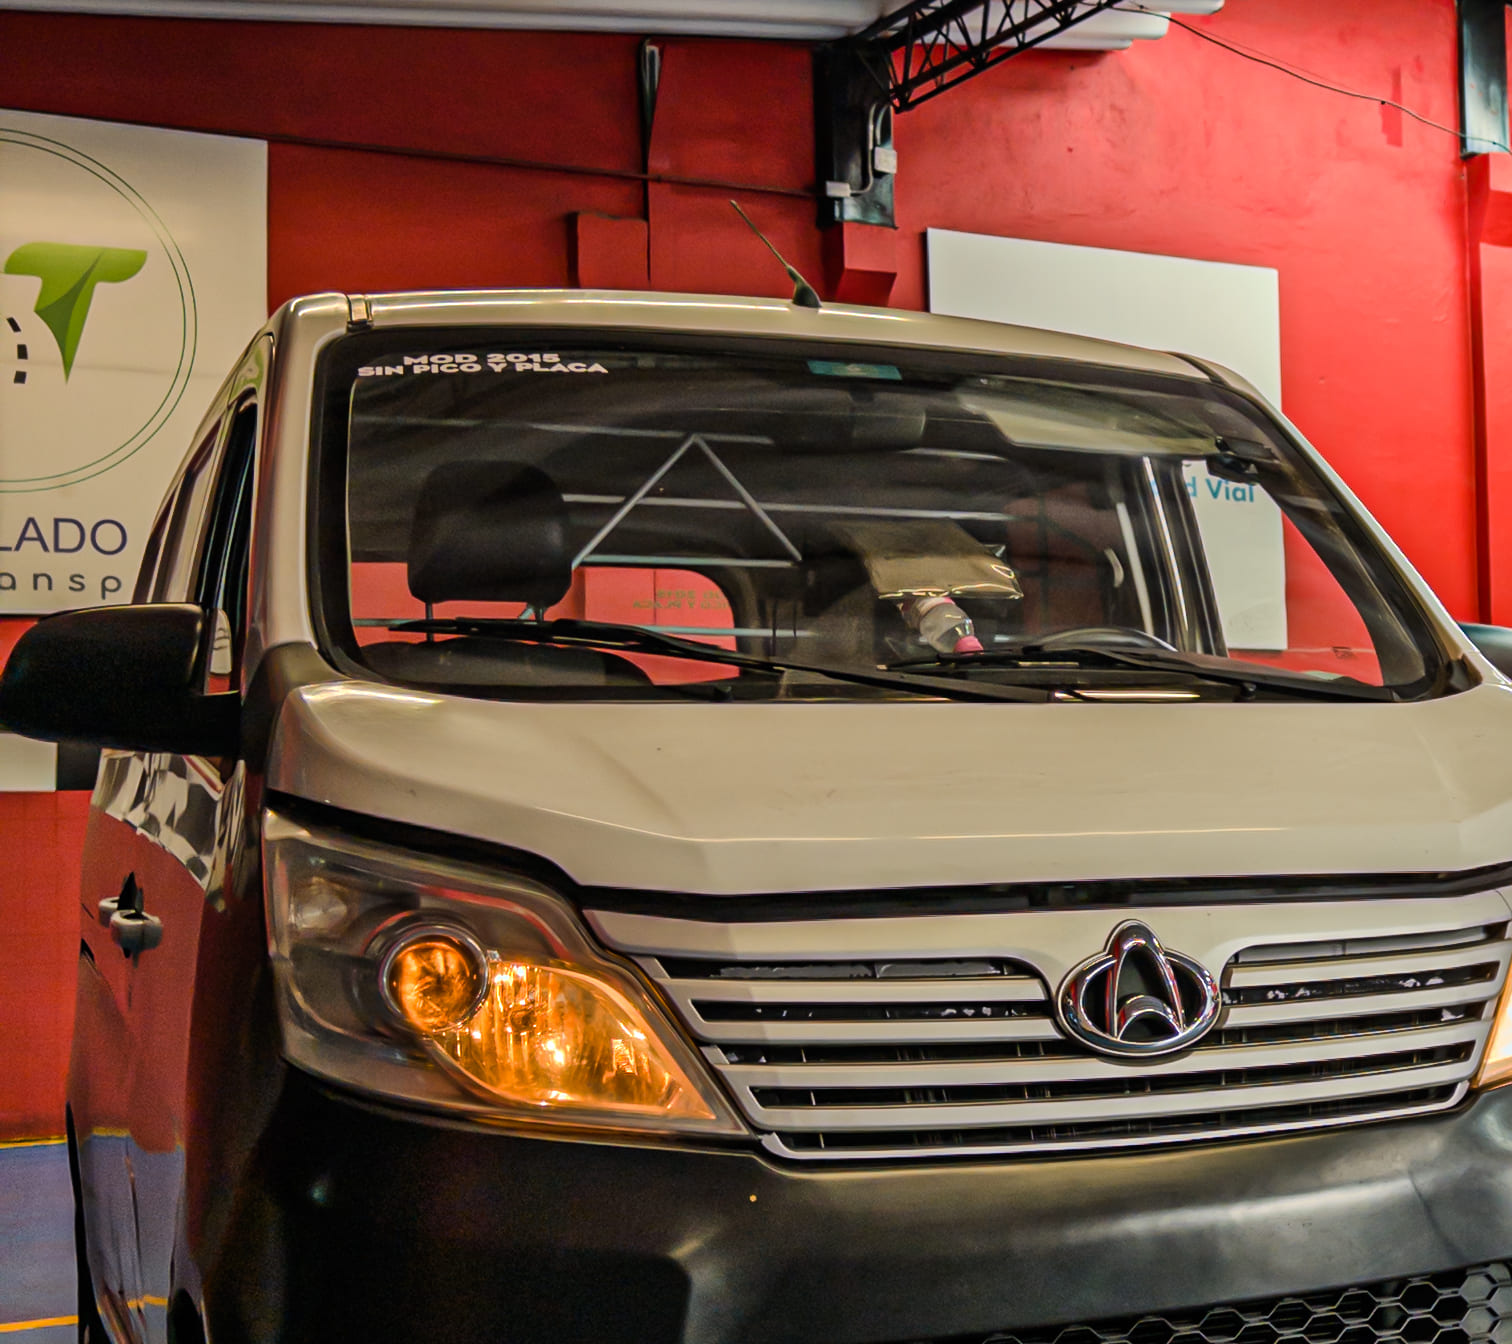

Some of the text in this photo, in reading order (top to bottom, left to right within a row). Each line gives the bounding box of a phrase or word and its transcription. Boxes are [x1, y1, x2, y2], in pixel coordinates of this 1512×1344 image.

[403, 353, 560, 365] MOD 2015
[358, 362, 609, 376] SIN PICO Y PLACA
[1205, 477, 1254, 503] Vial
